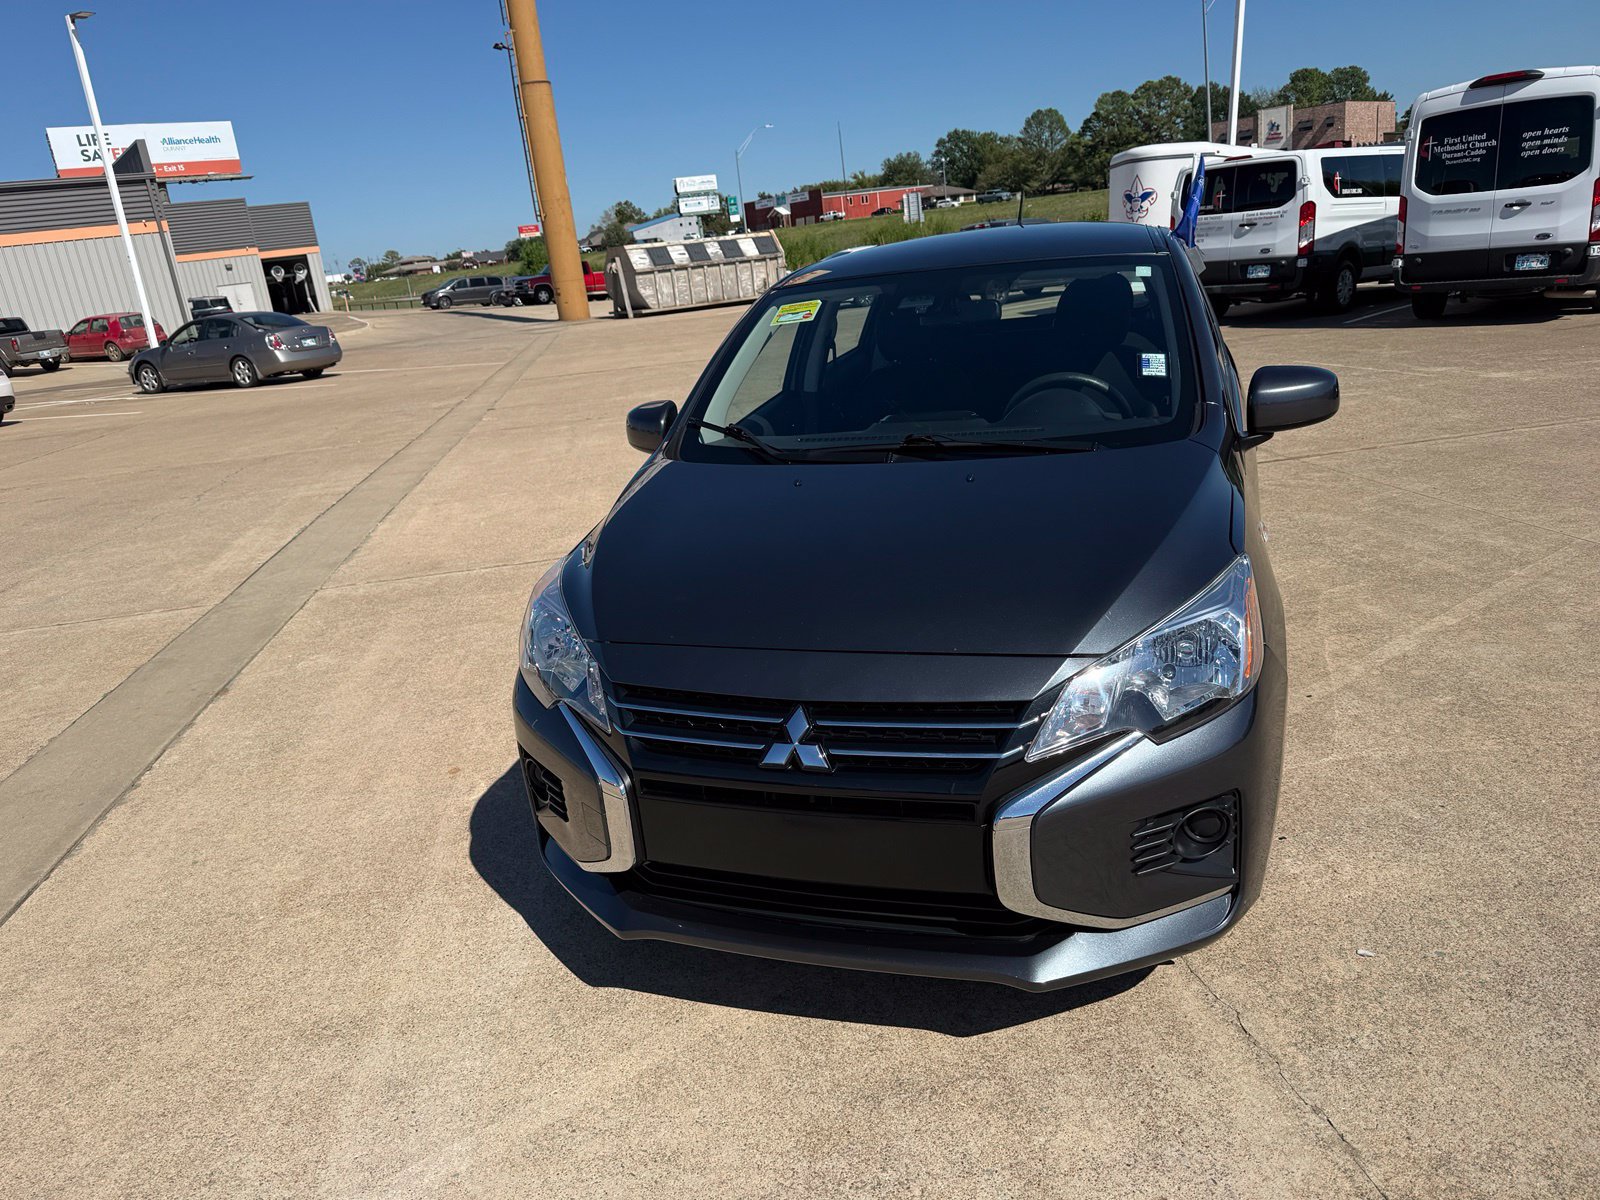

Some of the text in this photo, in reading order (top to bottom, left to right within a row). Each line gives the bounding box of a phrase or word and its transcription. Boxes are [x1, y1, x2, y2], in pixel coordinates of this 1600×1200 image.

[1443, 132, 1487, 145] First United
[1522, 126, 1570, 140] open hearts
[161, 135, 221, 146] AllianceHealth
[1433, 139, 1497, 153] Methodist Church
[1521, 135, 1569, 149] open minds
[1442, 148, 1487, 159] Durant-Caddo
[1520, 146, 1565, 158] open doors
